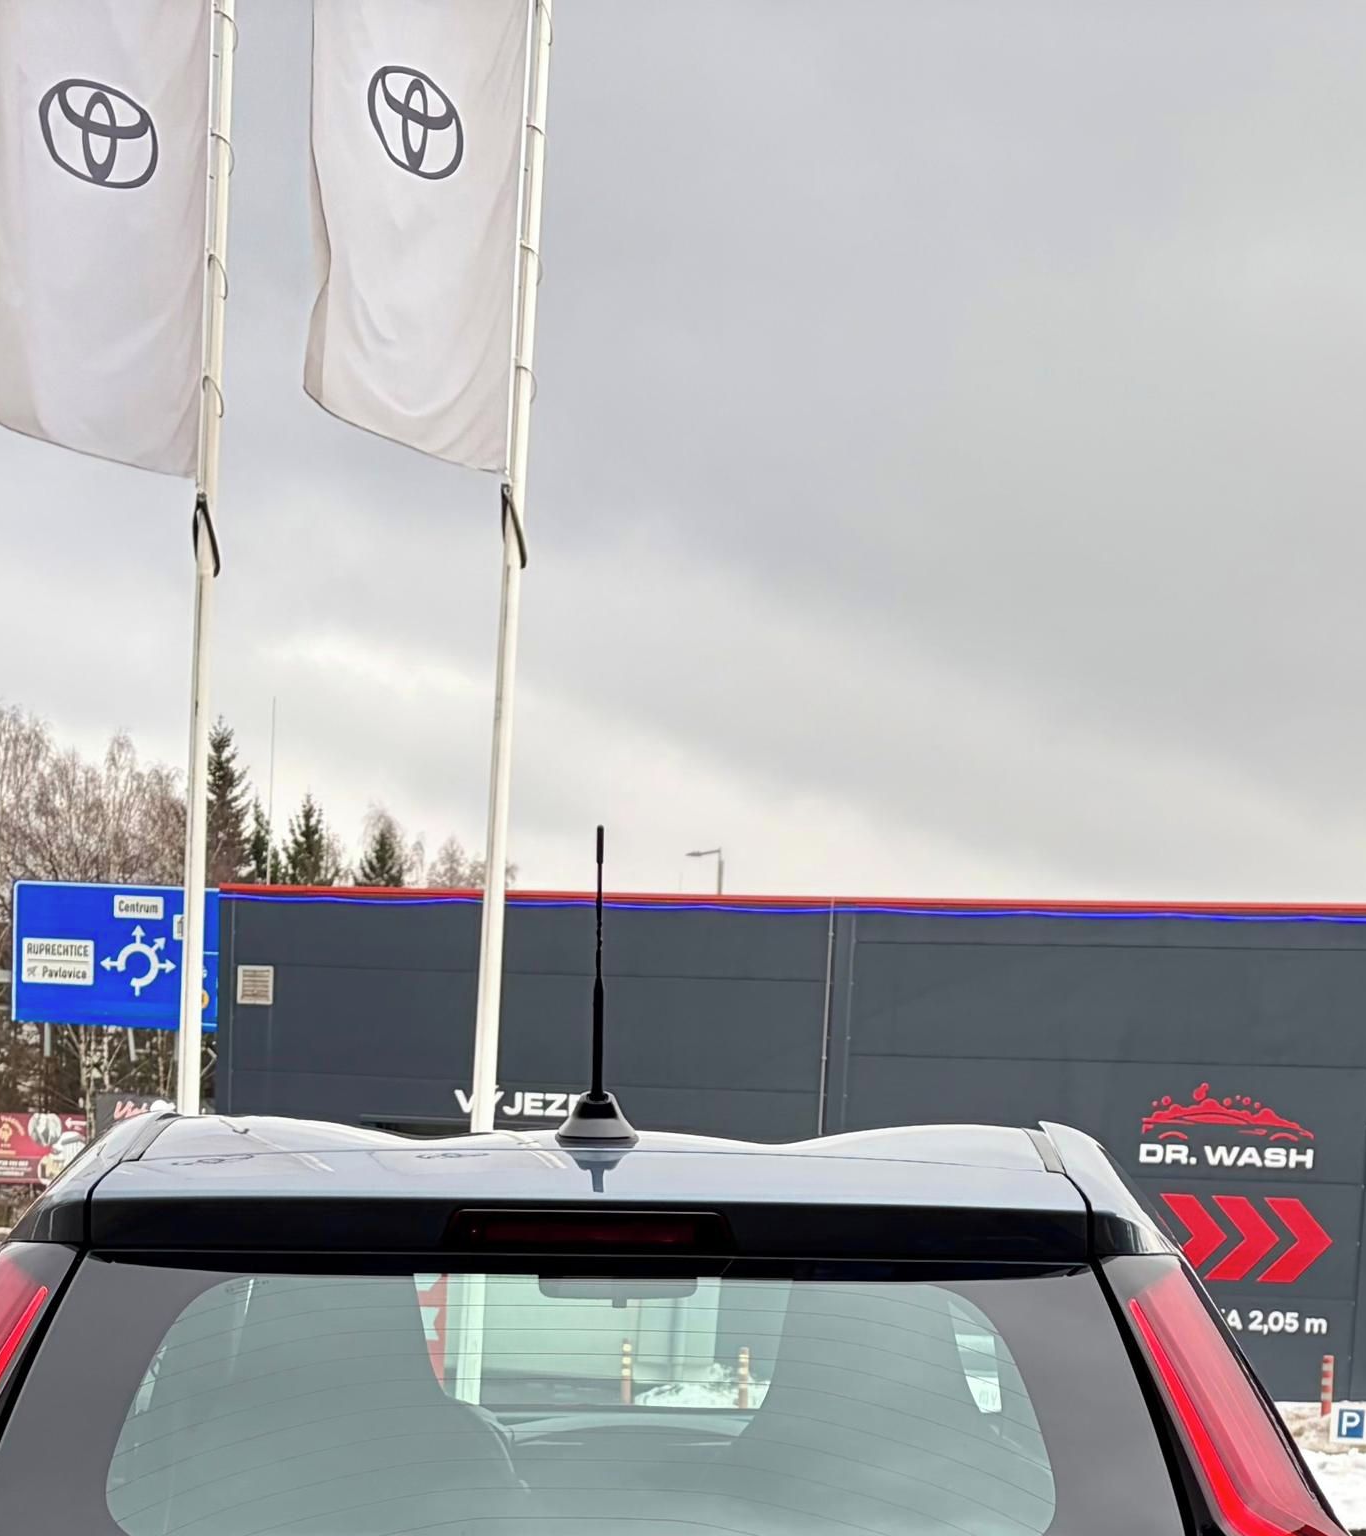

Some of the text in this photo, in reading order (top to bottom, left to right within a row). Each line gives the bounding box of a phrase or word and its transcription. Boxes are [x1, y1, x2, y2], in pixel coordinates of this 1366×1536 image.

[118, 901, 159, 914] Centrum
[27, 942, 90, 958] RUPRECHTICE
[42, 965, 87, 980] Pavlovice
[1139, 1143, 1314, 1169] DR. WASH
[1248, 1310, 1299, 1335] 2,05
[1305, 1316, 1328, 1334] m
[1341, 1412, 1361, 1436] P
